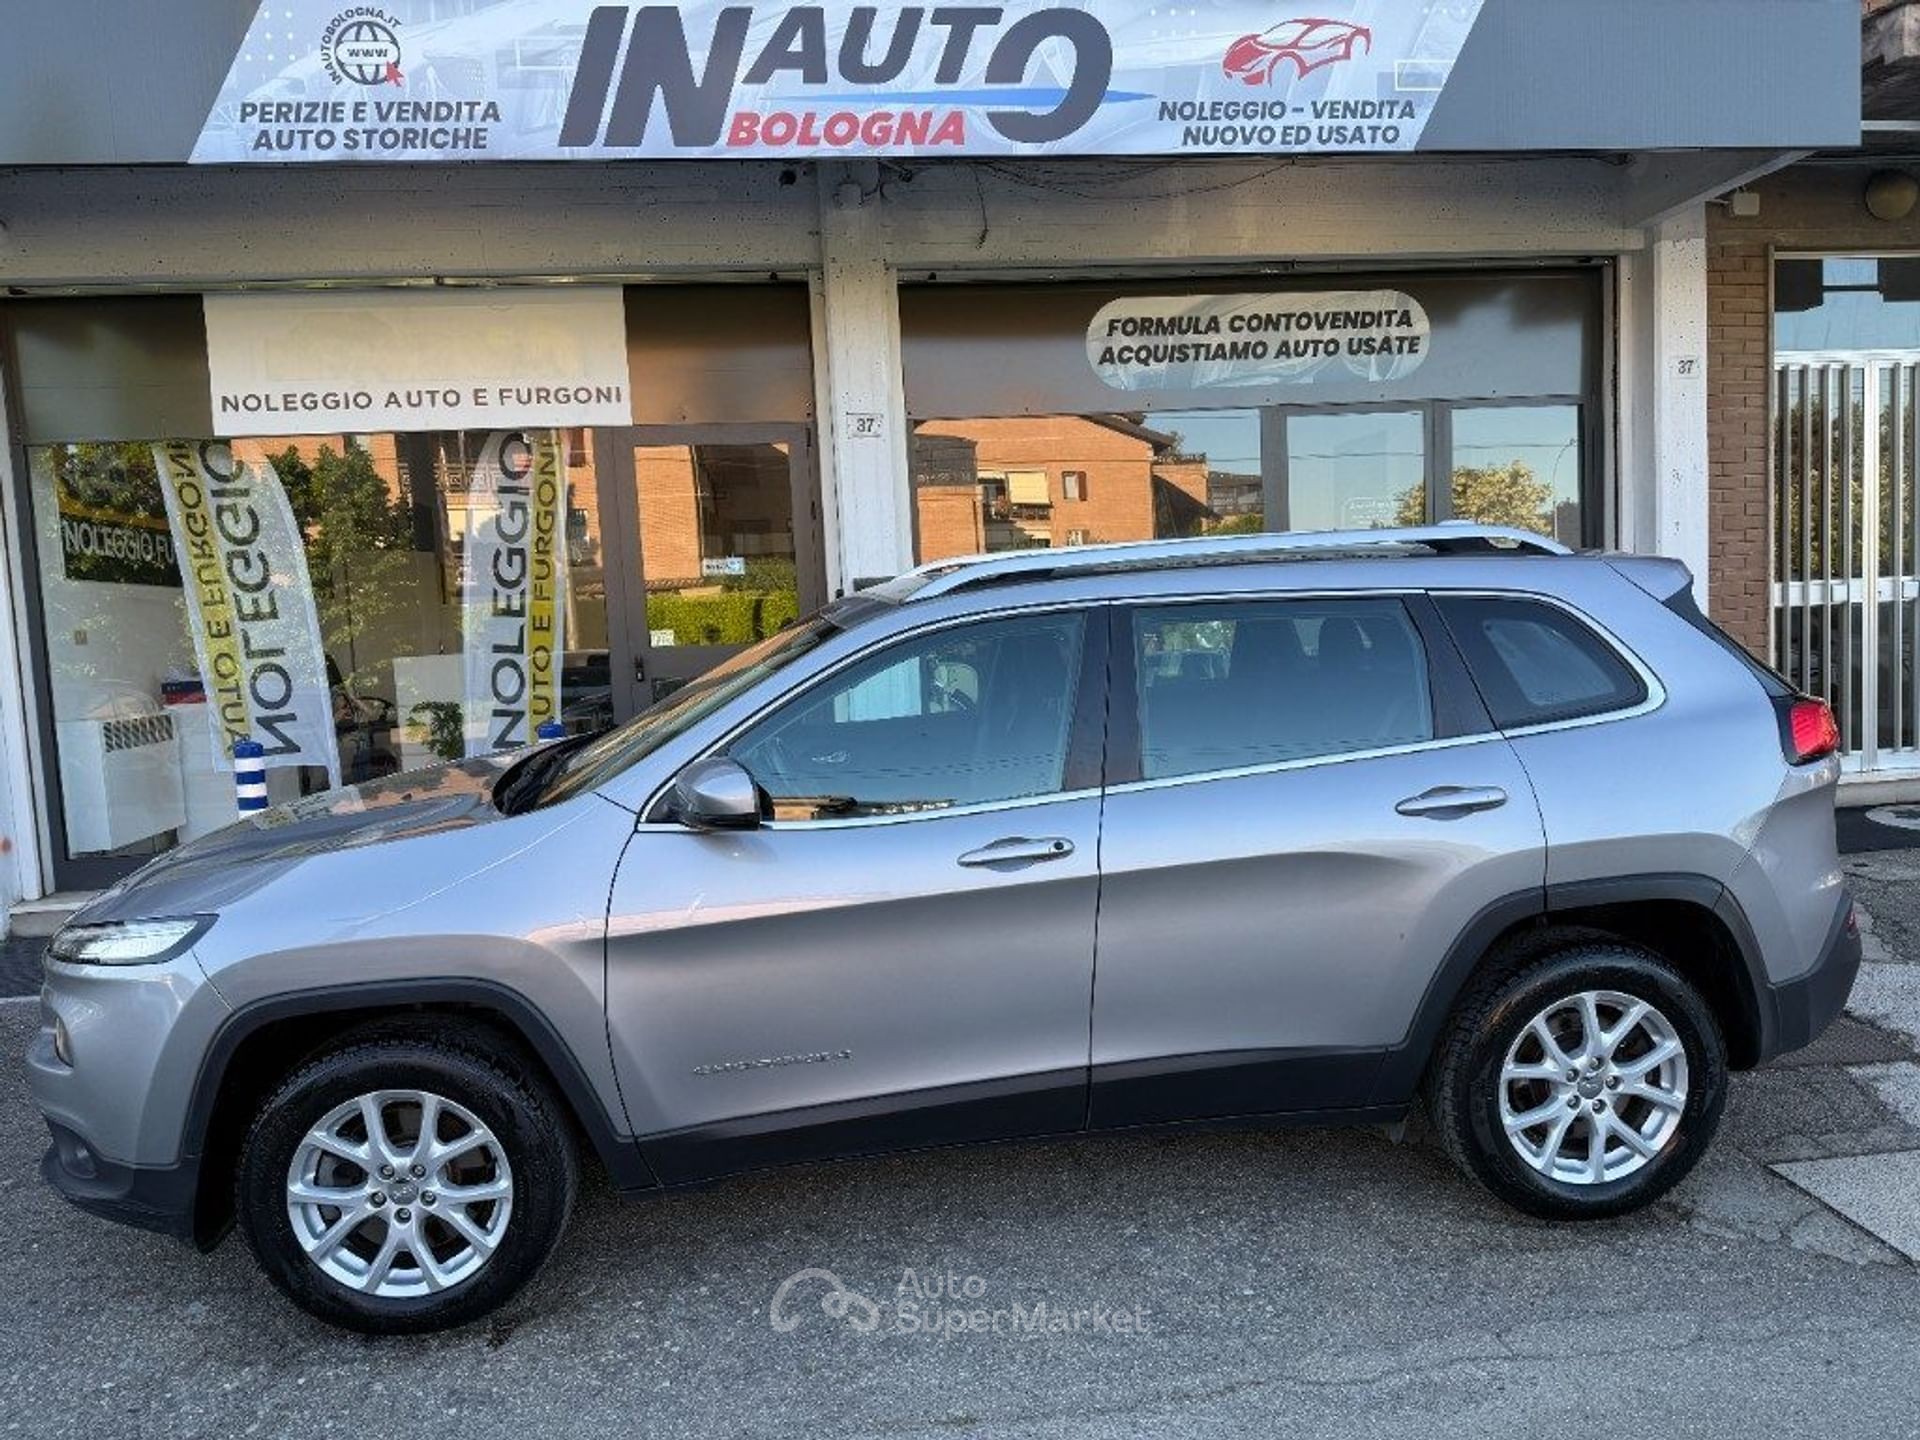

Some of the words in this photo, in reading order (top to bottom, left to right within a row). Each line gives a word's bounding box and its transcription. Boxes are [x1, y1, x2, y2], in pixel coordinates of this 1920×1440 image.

[320, 7, 403, 86] INAUTOBOLOGNA.IT
[240, 101, 346, 123] PERIZIE
[352, 101, 367, 123] E
[374, 101, 501, 123] VENDITA
[1158, 100, 1286, 121] NOLEGGIO
[1312, 99, 1416, 120] VENDITA
[252, 129, 336, 151] AUTO
[343, 128, 488, 150] STORICHE
[726, 111, 966, 147] BOLOGNA
[1182, 125, 1276, 146] NUOVO
[1280, 125, 1312, 146] ED
[1316, 125, 1401, 145] USATO
[1106, 315, 1220, 337] FORMULA
[1229, 309, 1413, 333] CONTOVENDITA
[1098, 341, 1268, 367] ACQUISTIAMO
[1274, 338, 1340, 360] AUTO
[1347, 336, 1421, 356] USATE
[221, 391, 372, 412] NOLEGGIO
[384, 389, 461, 408] AUTO
[473, 388, 489, 406] E
[499, 386, 622, 406] FURGONI
[857, 418, 875, 432] 37
[534, 441, 556, 601] FURGONI
[62, 519, 152, 562] NOLEGGIO
[492, 432, 532, 749] NOLEGGIO
[532, 615, 550, 632] E
[533, 645, 551, 733] UTO
